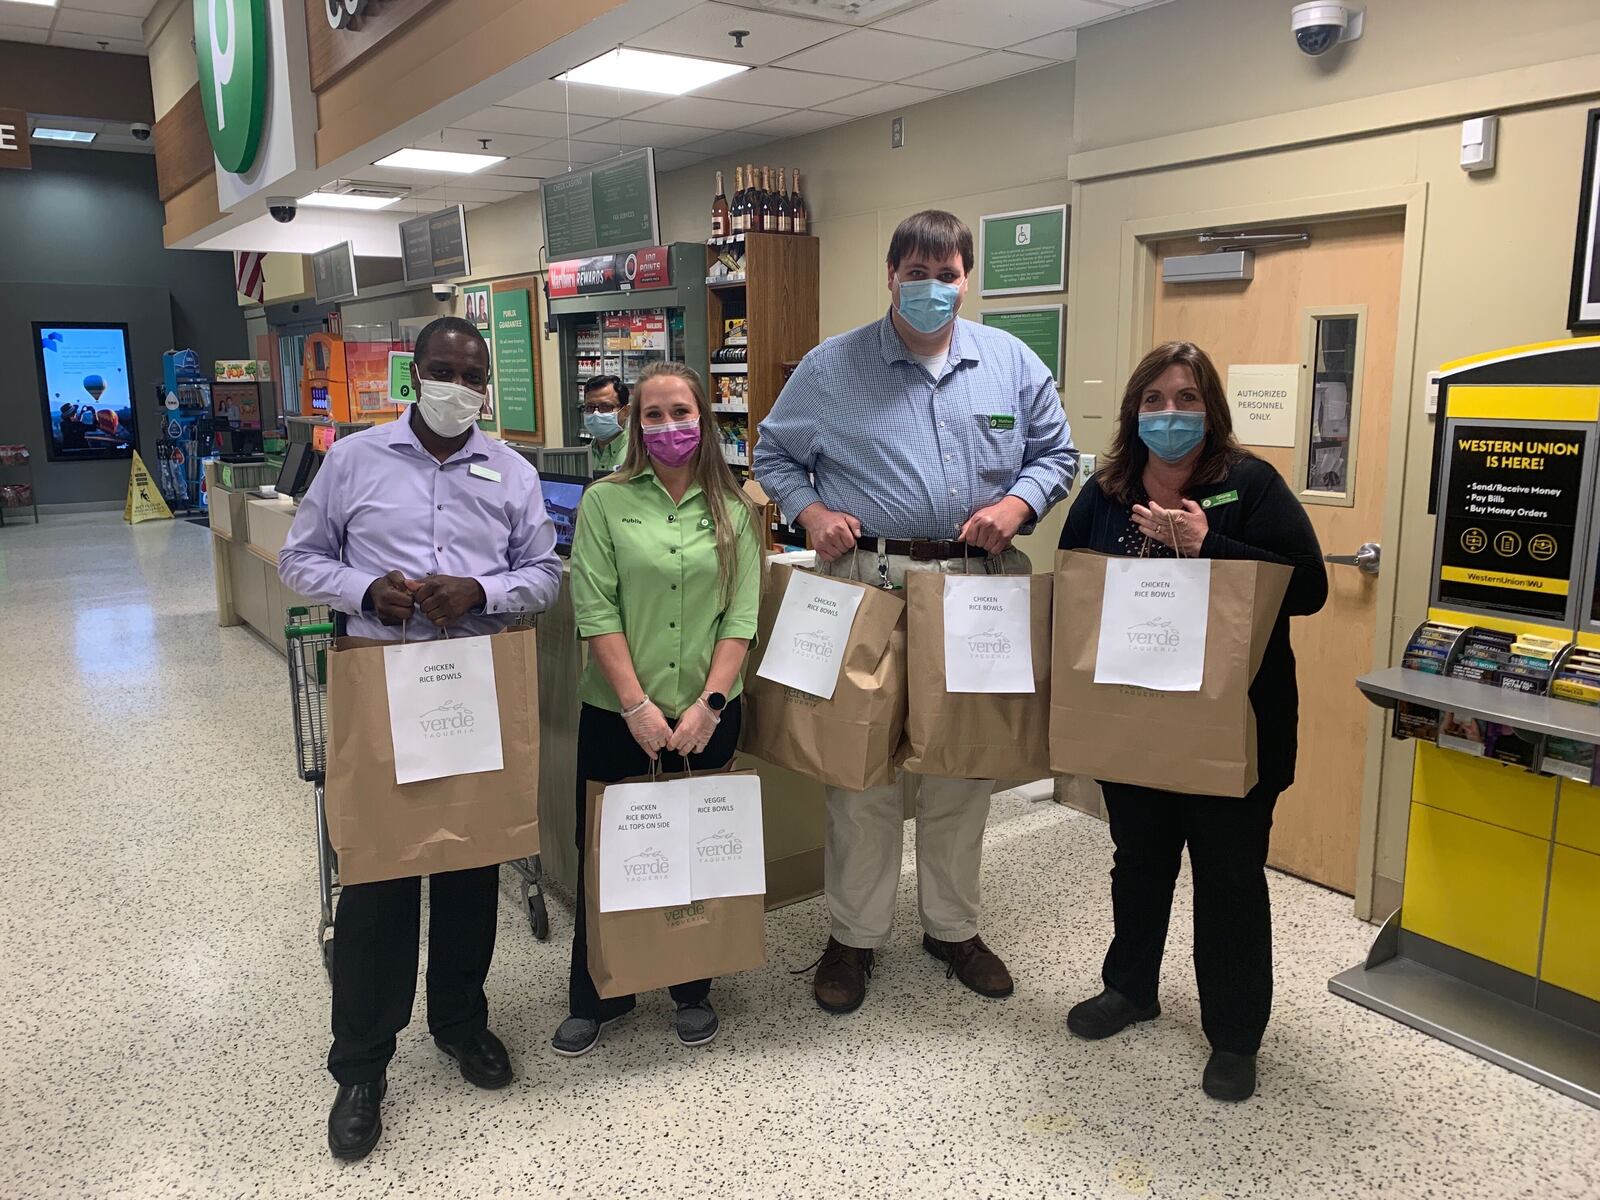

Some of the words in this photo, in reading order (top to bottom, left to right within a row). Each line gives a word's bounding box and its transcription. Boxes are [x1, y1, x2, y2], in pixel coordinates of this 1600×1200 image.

[576, 269, 604, 286] REWARDS
[1237, 390, 1287, 398] AUTHORIZED
[1238, 402, 1285, 410] PERSONNEL
[1249, 413, 1272, 421] ONLY.
[1458, 439, 1523, 453] WESTERN
[1527, 442, 1579, 456] UNION
[1486, 455, 1498, 468] IS
[1501, 456, 1544, 470] HERE!
[1471, 482, 1530, 494] Send/Receive
[1531, 486, 1562, 498] Money
[1470, 494, 1486, 503] Pay
[1488, 494, 1505, 504] Bills
[1470, 504, 1486, 514] Buy
[1488, 506, 1516, 517] Money
[1517, 508, 1548, 518] Orders
[814, 596, 837, 608] CHICKEN
[807, 604, 820, 612] RICE
[820, 607, 838, 617] BOWLS
[424, 663, 455, 672] CHICKEN
[419, 675, 434, 683] RICE
[436, 672, 462, 682] BOWLS
[424, 728, 475, 739] TAQUERIA
[704, 796, 726, 804] VEGGIE
